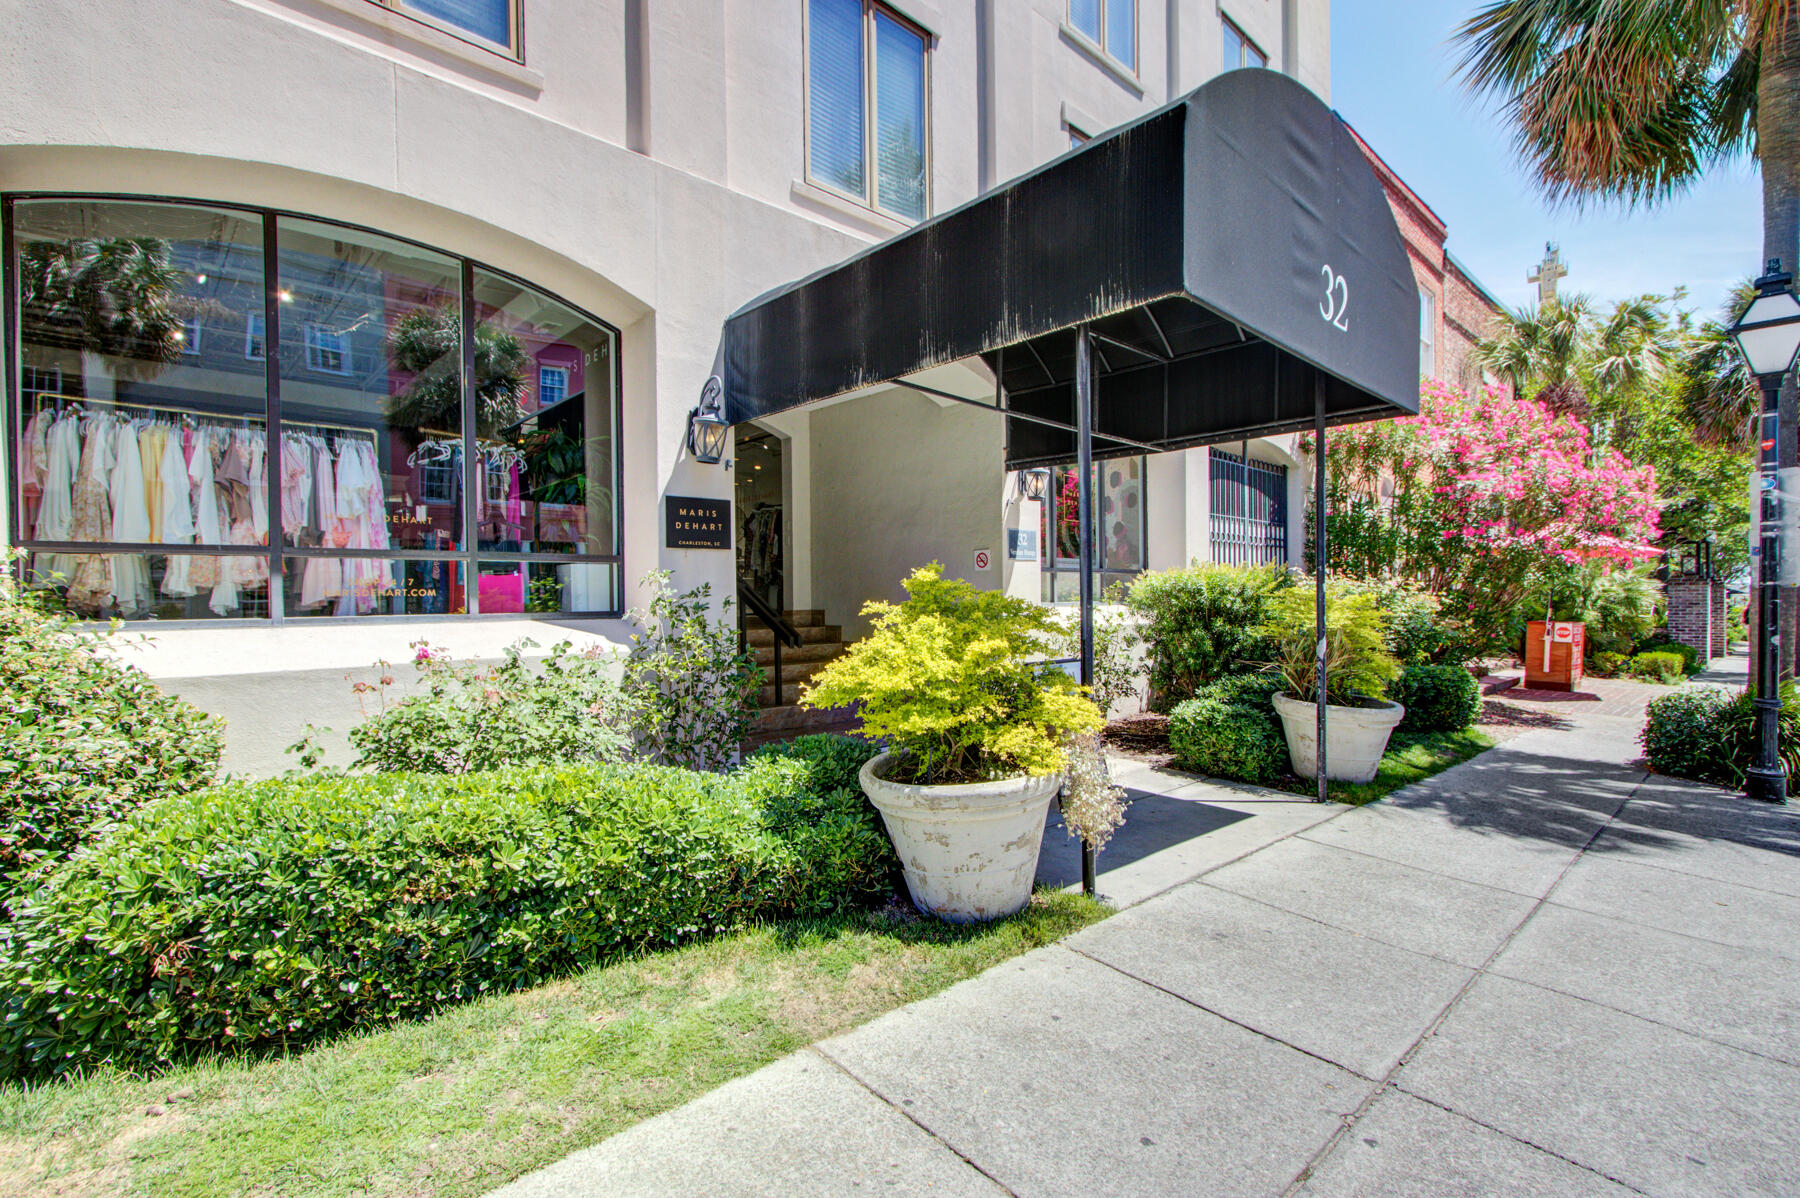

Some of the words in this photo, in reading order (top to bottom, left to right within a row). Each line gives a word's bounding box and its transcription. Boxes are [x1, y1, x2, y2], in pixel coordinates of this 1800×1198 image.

[1319, 264, 1348, 332] 32
[679, 508, 717, 518] MARIS
[675, 521, 723, 531] DEHART
